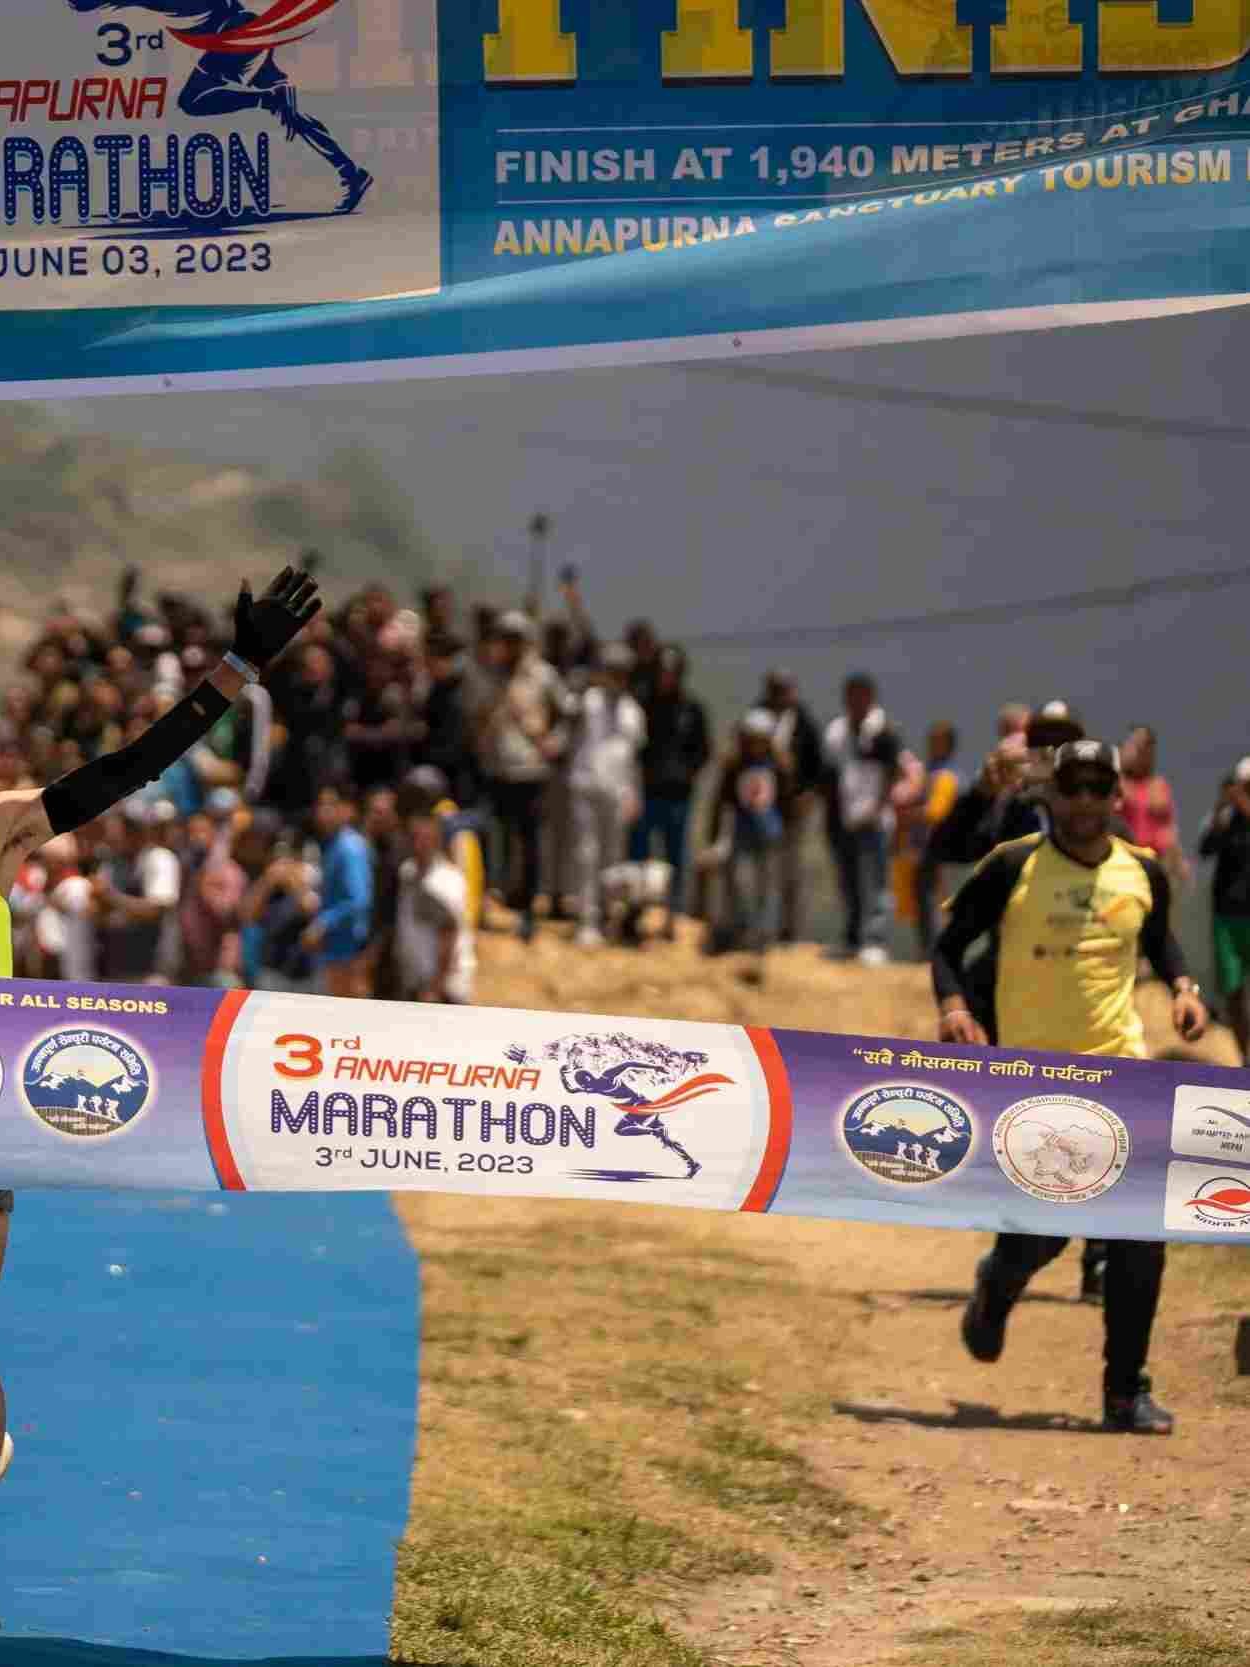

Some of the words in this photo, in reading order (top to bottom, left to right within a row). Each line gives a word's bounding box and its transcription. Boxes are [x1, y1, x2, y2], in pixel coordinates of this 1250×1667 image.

[96, 22, 164, 67] 3rd
[495, 149, 656, 184] FINISH
[672, 147, 733, 180] AT
[750, 144, 875, 185] 1,940
[891, 131, 1087, 176] METERS
[1102, 115, 1160, 143] AT
[493, 215, 758, 256] ANNAPURNA
[1040, 149, 1231, 192] TOURISM
[102, 244, 162, 279] 03,
[174, 242, 272, 274] 2023
[20, 993, 61, 1009] ALL
[66, 996, 168, 1014] SEASONS
[333, 1056, 542, 1093] ANNAPURNA
[270, 1088, 597, 1150] MARATHON
[315, 1147, 353, 1168] 3rd
[360, 1148, 449, 1174] JUNE,
[457, 1152, 535, 1175] 2023
